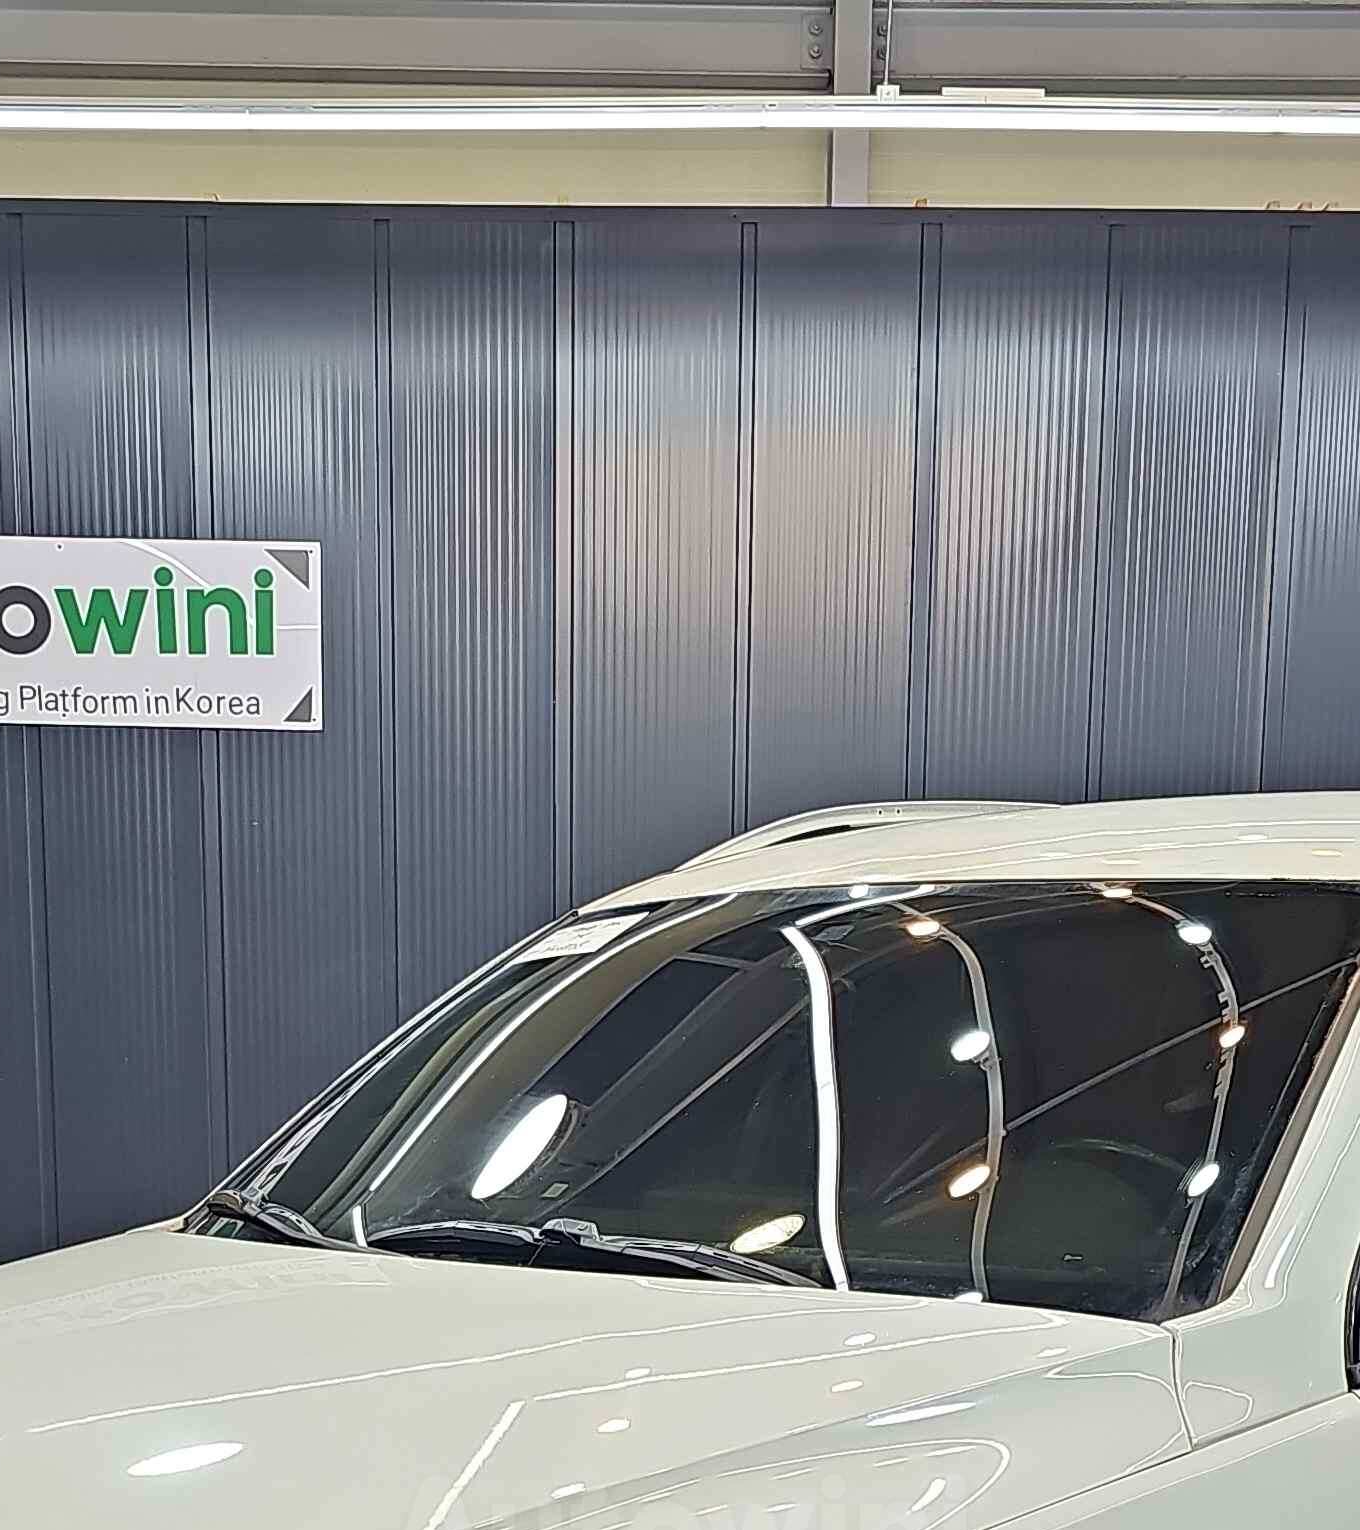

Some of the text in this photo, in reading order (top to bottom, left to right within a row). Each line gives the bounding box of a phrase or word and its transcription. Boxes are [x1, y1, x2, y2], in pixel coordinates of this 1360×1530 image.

[18, 684, 138, 715] Platform
[144, 687, 170, 715] in
[175, 687, 261, 715] Korea
